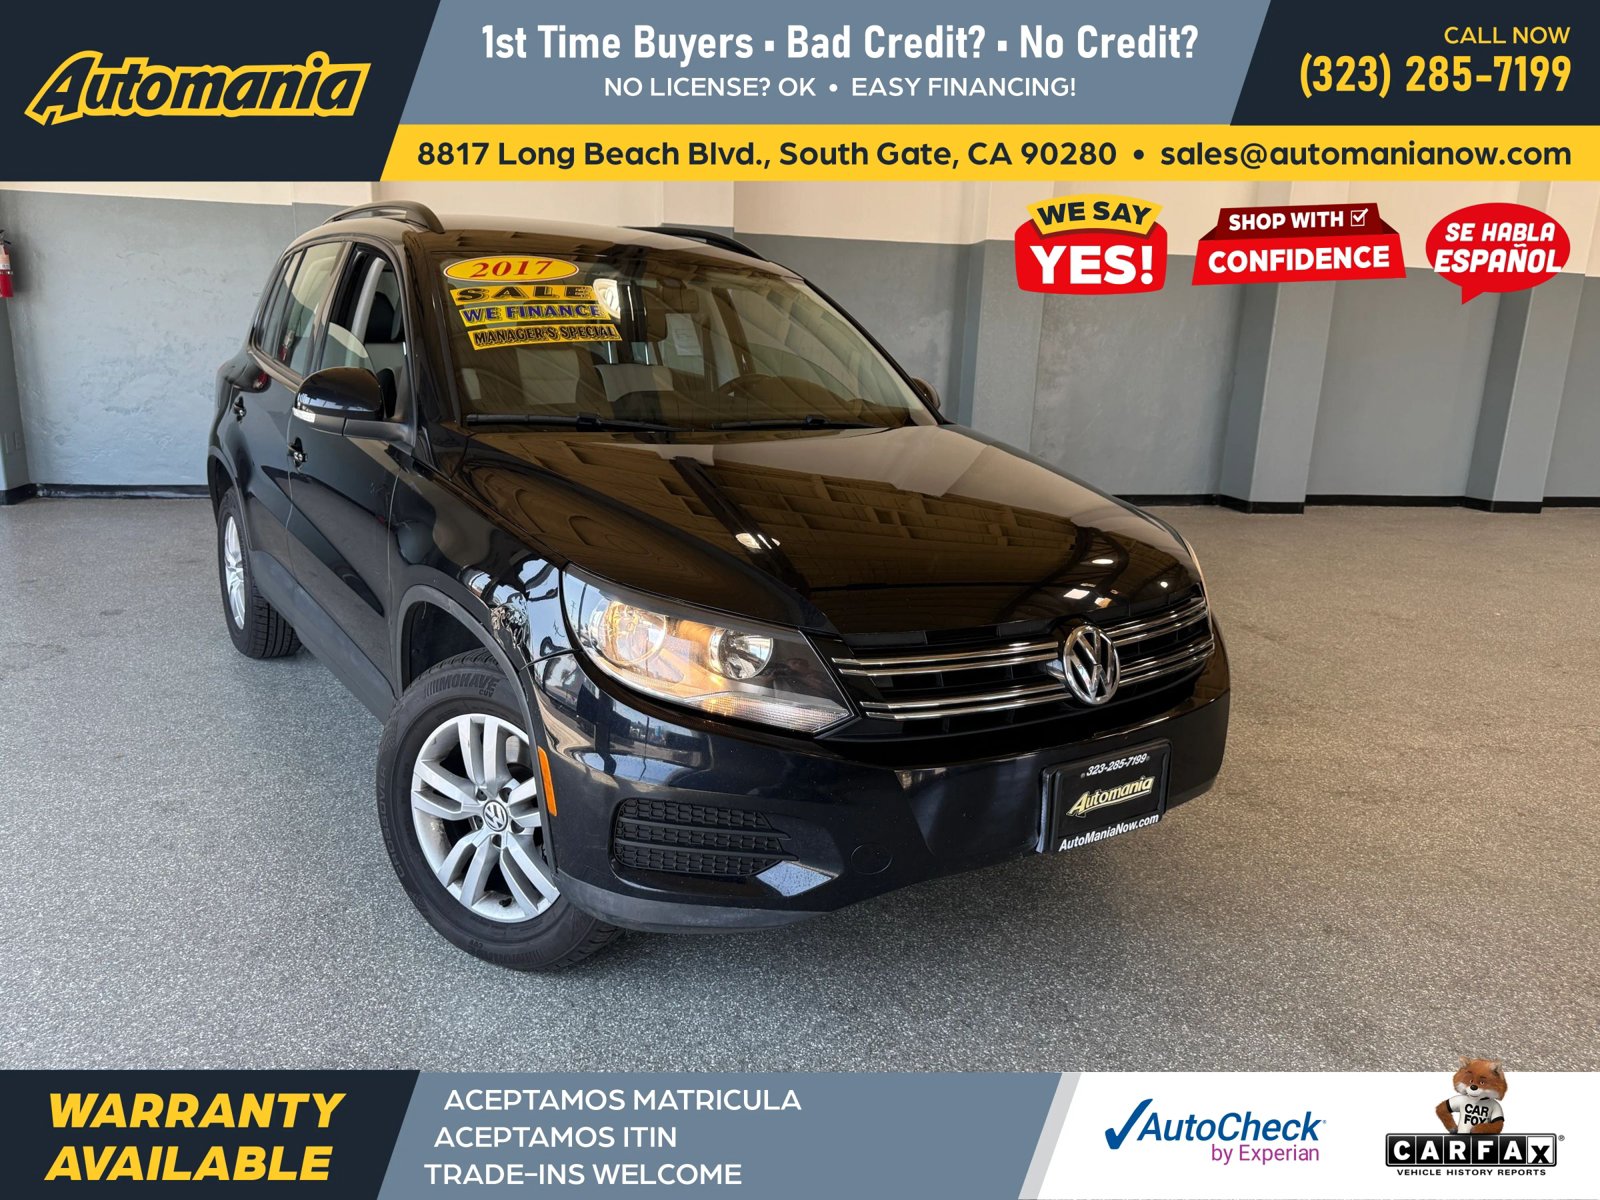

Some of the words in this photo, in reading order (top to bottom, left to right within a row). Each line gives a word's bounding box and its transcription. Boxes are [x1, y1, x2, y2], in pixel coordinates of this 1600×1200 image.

[469, 260, 553, 278] 2017
[457, 286, 593, 301] SALE
[463, 307, 498, 323] WE
[507, 304, 601, 320] FINANCE
[473, 326, 558, 346] MANAGER'S
[560, 324, 617, 340] SPECIAL
[1087, 753, 1147, 777] 323-285-7199
[1066, 775, 1155, 817] Automania
[1058, 814, 1160, 852] AutoManiaNow.com
